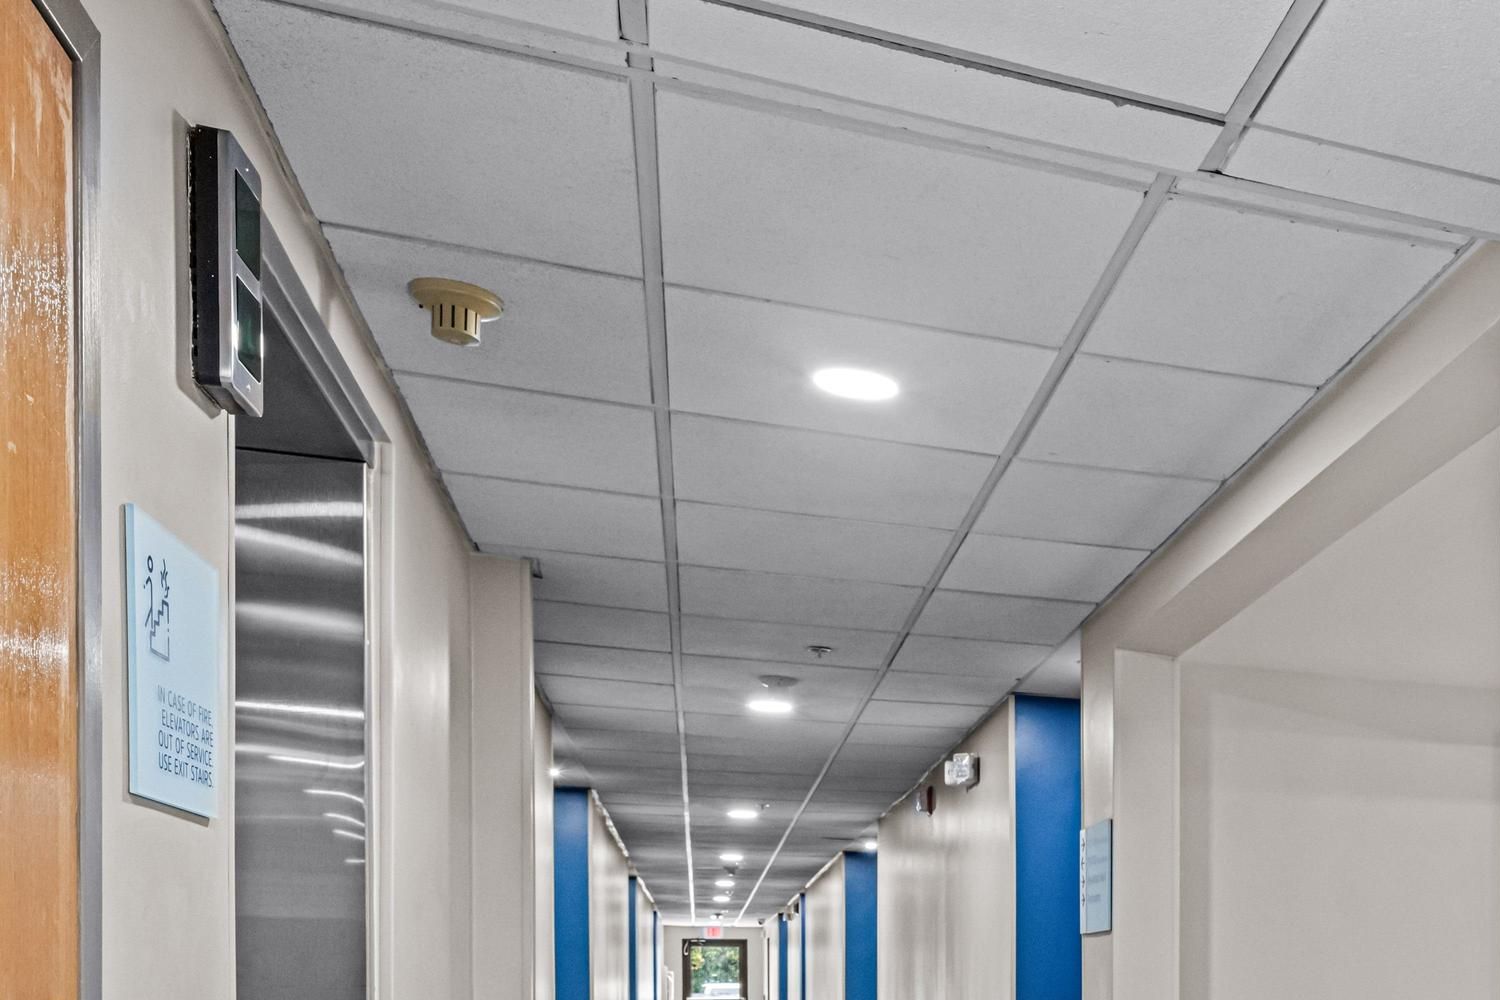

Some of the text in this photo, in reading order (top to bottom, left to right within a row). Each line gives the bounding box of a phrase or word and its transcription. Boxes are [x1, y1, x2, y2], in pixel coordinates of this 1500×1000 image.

[158, 685, 165, 704] IN
[168, 690, 185, 714] CASE
[187, 700, 196, 718] OF
[158, 730, 173, 751] OUT
[175, 737, 184, 755] OF
[162, 709, 213, 747] ELEVATORS ARE
[158, 751, 172, 773] USE
[174, 758, 189, 778] EXIT
